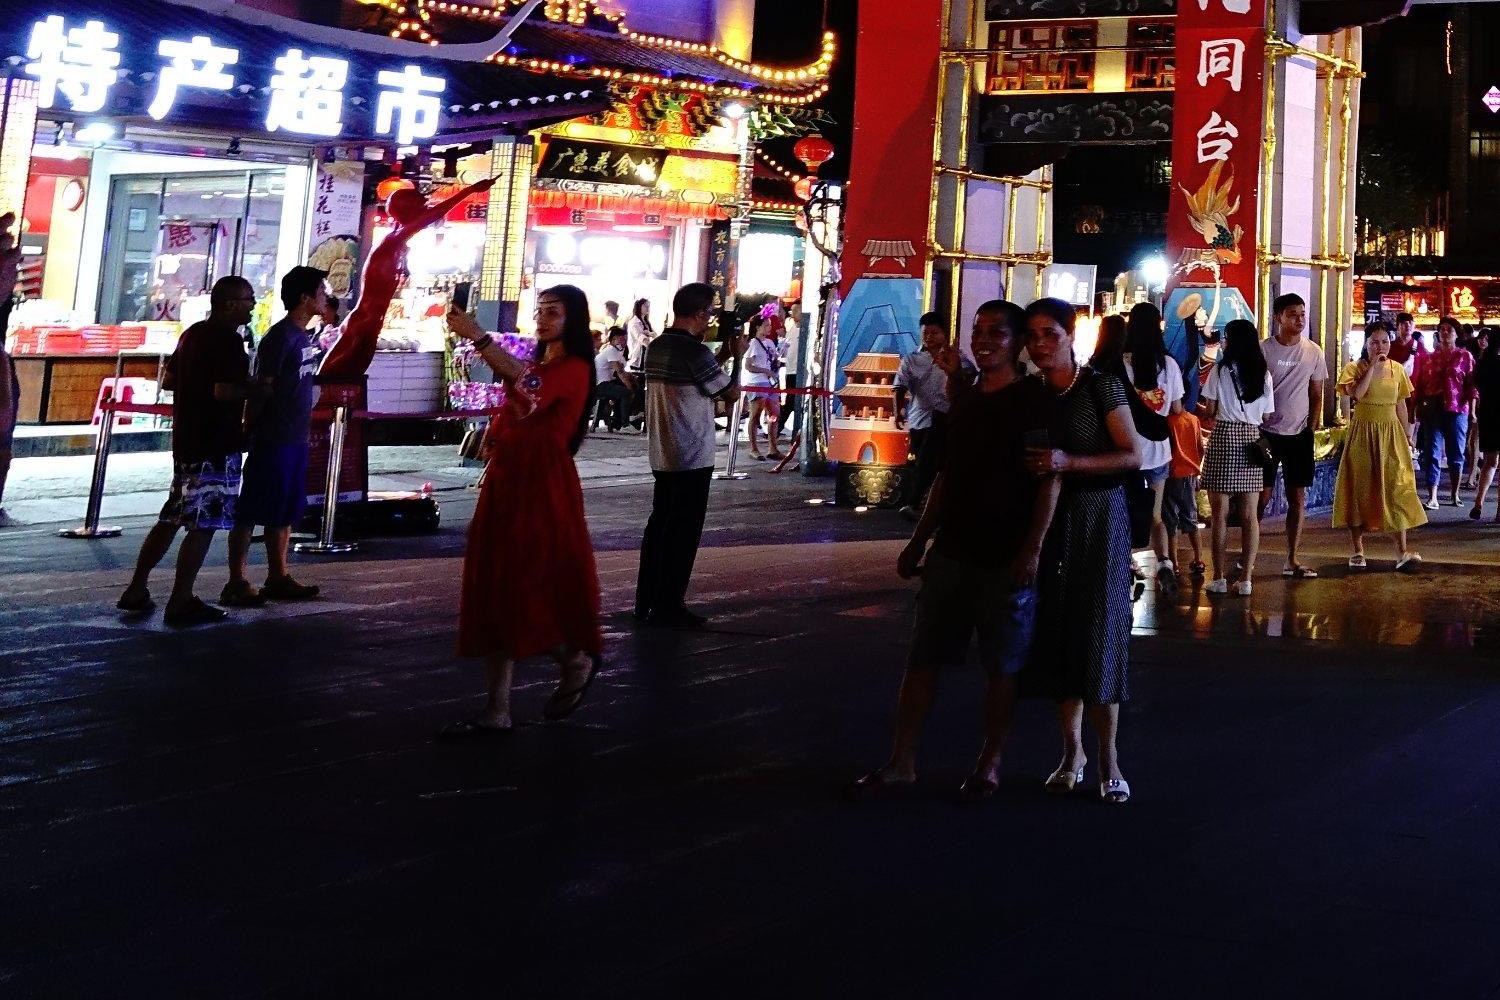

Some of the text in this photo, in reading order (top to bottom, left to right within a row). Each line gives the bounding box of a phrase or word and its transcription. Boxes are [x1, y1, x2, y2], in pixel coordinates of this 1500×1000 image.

[24, 14, 447, 145] 特产超市
[550, 147, 660, 182] 广惠美食
